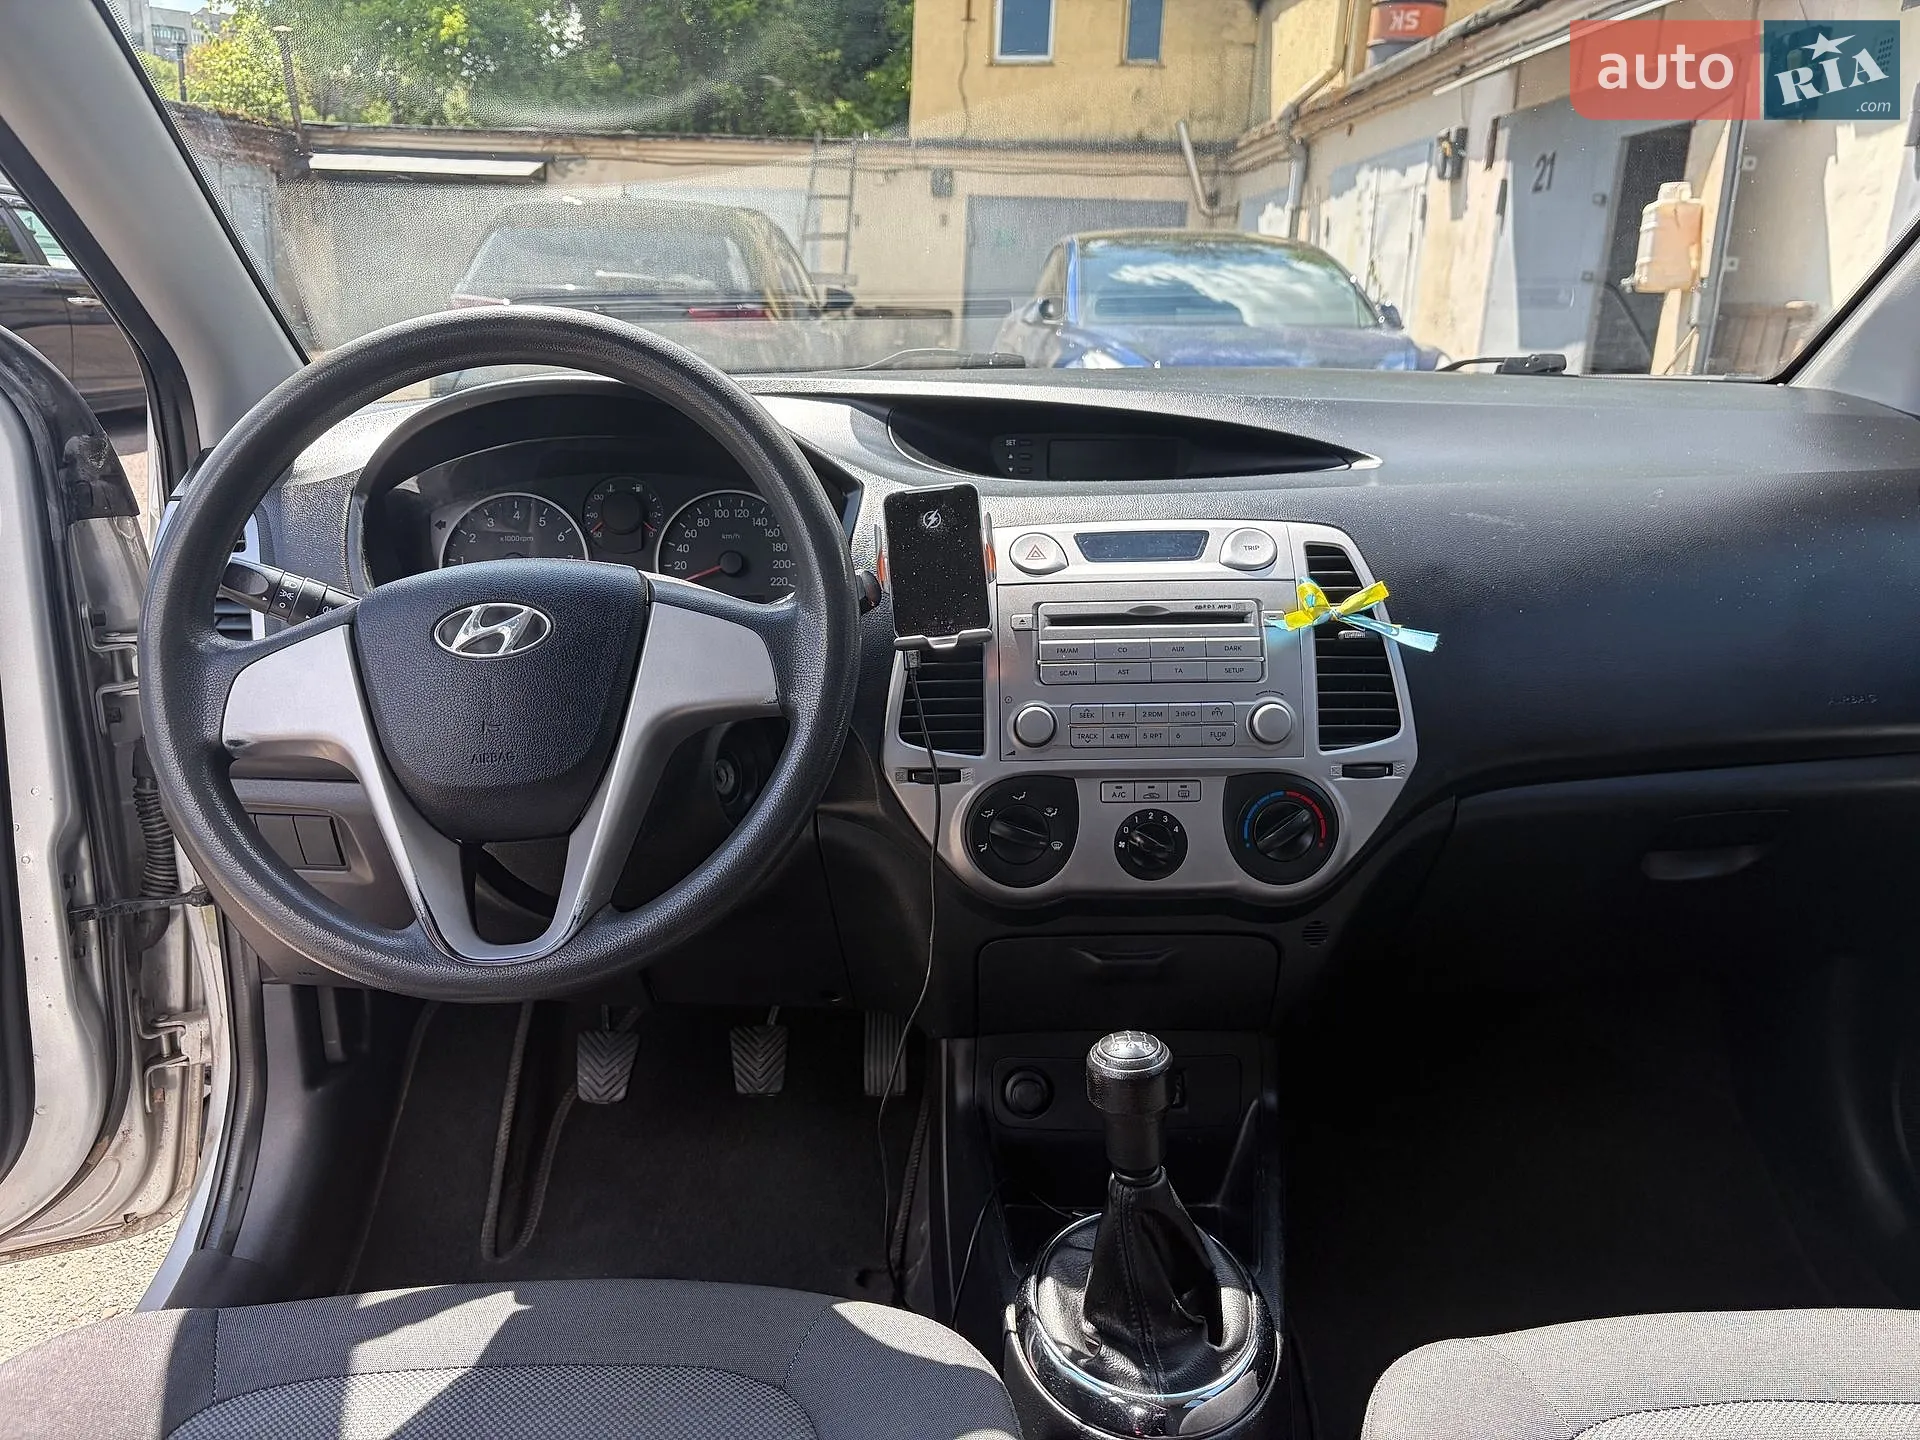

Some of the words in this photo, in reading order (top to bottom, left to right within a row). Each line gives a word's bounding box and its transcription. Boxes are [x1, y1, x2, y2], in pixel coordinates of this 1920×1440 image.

[1531, 151, 1556, 194] 21
[1005, 439, 1017, 447] SET
[513, 511, 521, 521] 4
[714, 509, 730, 519] 100
[734, 509, 750, 518] 120
[487, 518, 495, 528] 3
[538, 517, 546, 527] 5
[697, 518, 710, 527] 80
[752, 518, 768, 527] 140
[557, 532, 565, 542] 6
[684, 530, 697, 539] 60
[721, 532, 741, 540] km/h
[764, 528, 780, 538] 160
[469, 533, 476, 543] 2
[676, 544, 690, 553] 40
[772, 542, 788, 552] 180
[674, 561, 687, 570] 20
[772, 560, 791, 569] 200
[770, 577, 788, 587] 220
[1134, 816, 1138, 824] 1
[1148, 811, 1154, 820] 2
[1162, 815, 1168, 823] 3
[1123, 826, 1129, 834] 0
[1173, 825, 1179, 833] 4
